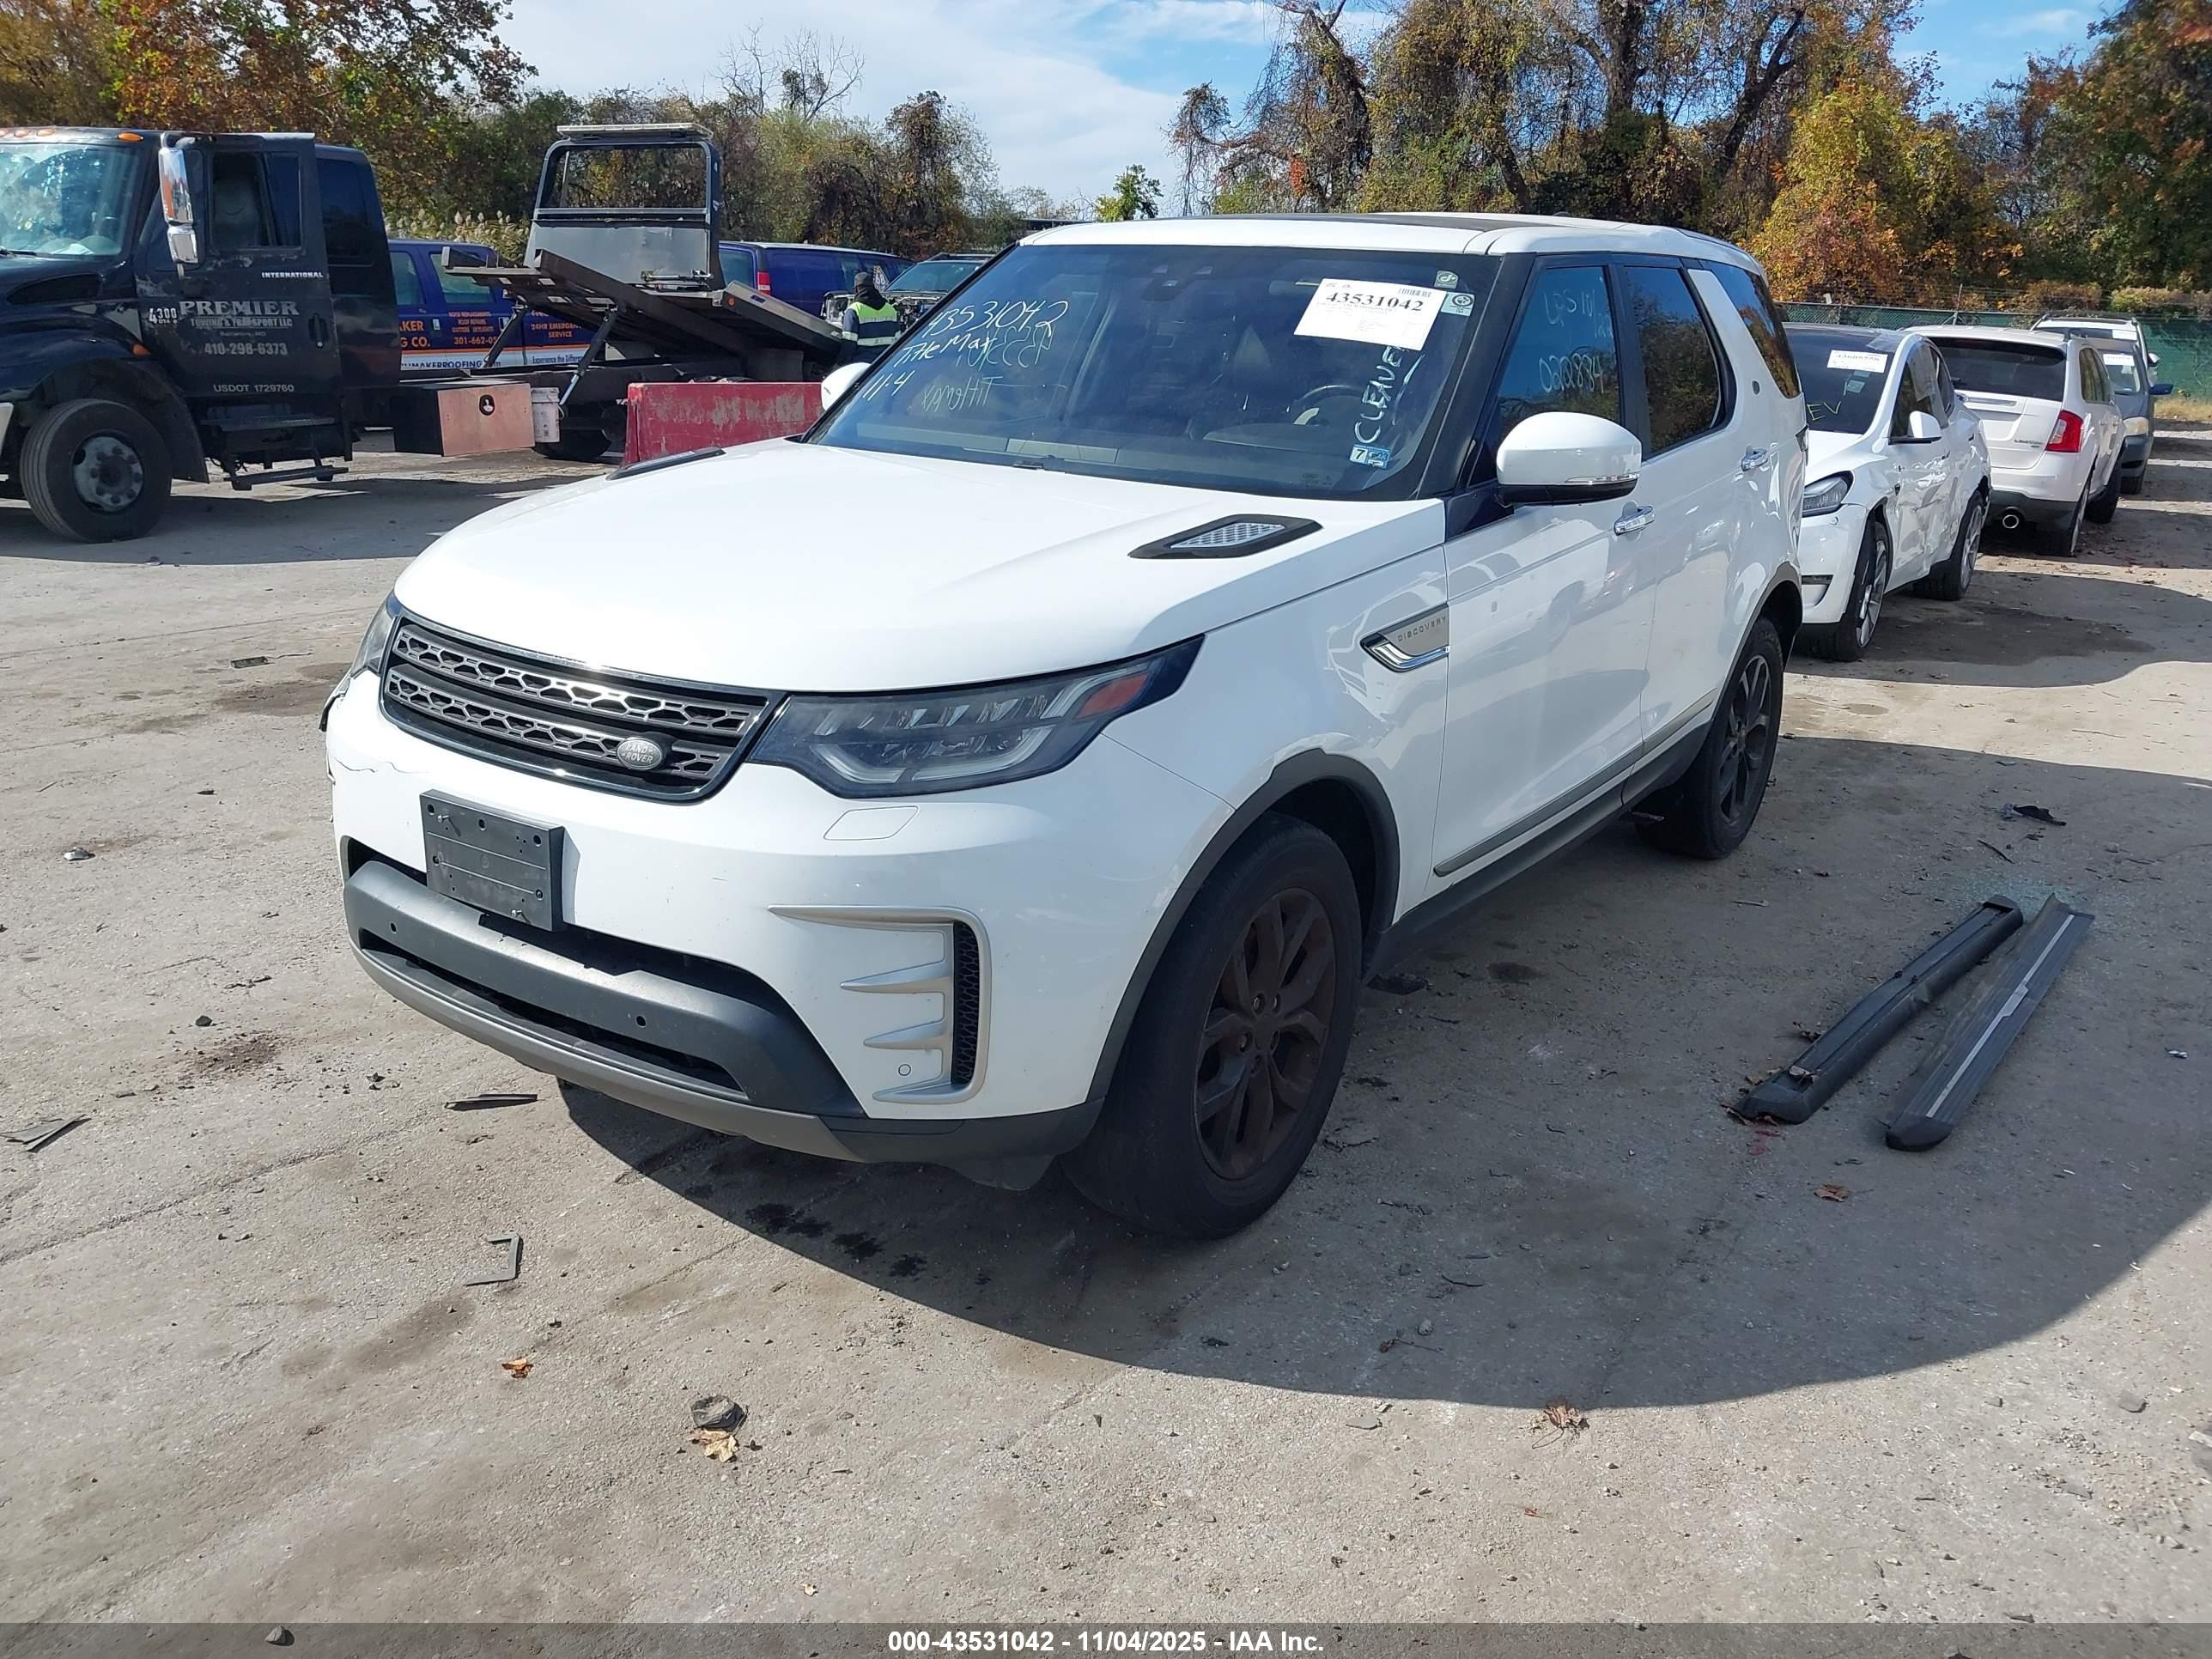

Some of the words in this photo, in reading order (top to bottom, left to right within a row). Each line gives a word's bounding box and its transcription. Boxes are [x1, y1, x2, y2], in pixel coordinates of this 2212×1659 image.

[179, 301, 300, 315] PREMIER
[1326, 292, 1424, 311] 43531042
[149, 307, 178, 324] 4300
[921, 301, 1069, 337] 43531042
[411, 336, 431, 347] CO.
[453, 336, 499, 345] 301-662-05
[213, 384, 249, 392] USDOT
[254, 384, 295, 392] 1729760
[1806, 400, 1842, 421] EV
[1398, 616, 1446, 642] DISCOVERY
[625, 743, 648, 754] LAND
[625, 752, 653, 763] ROVER
